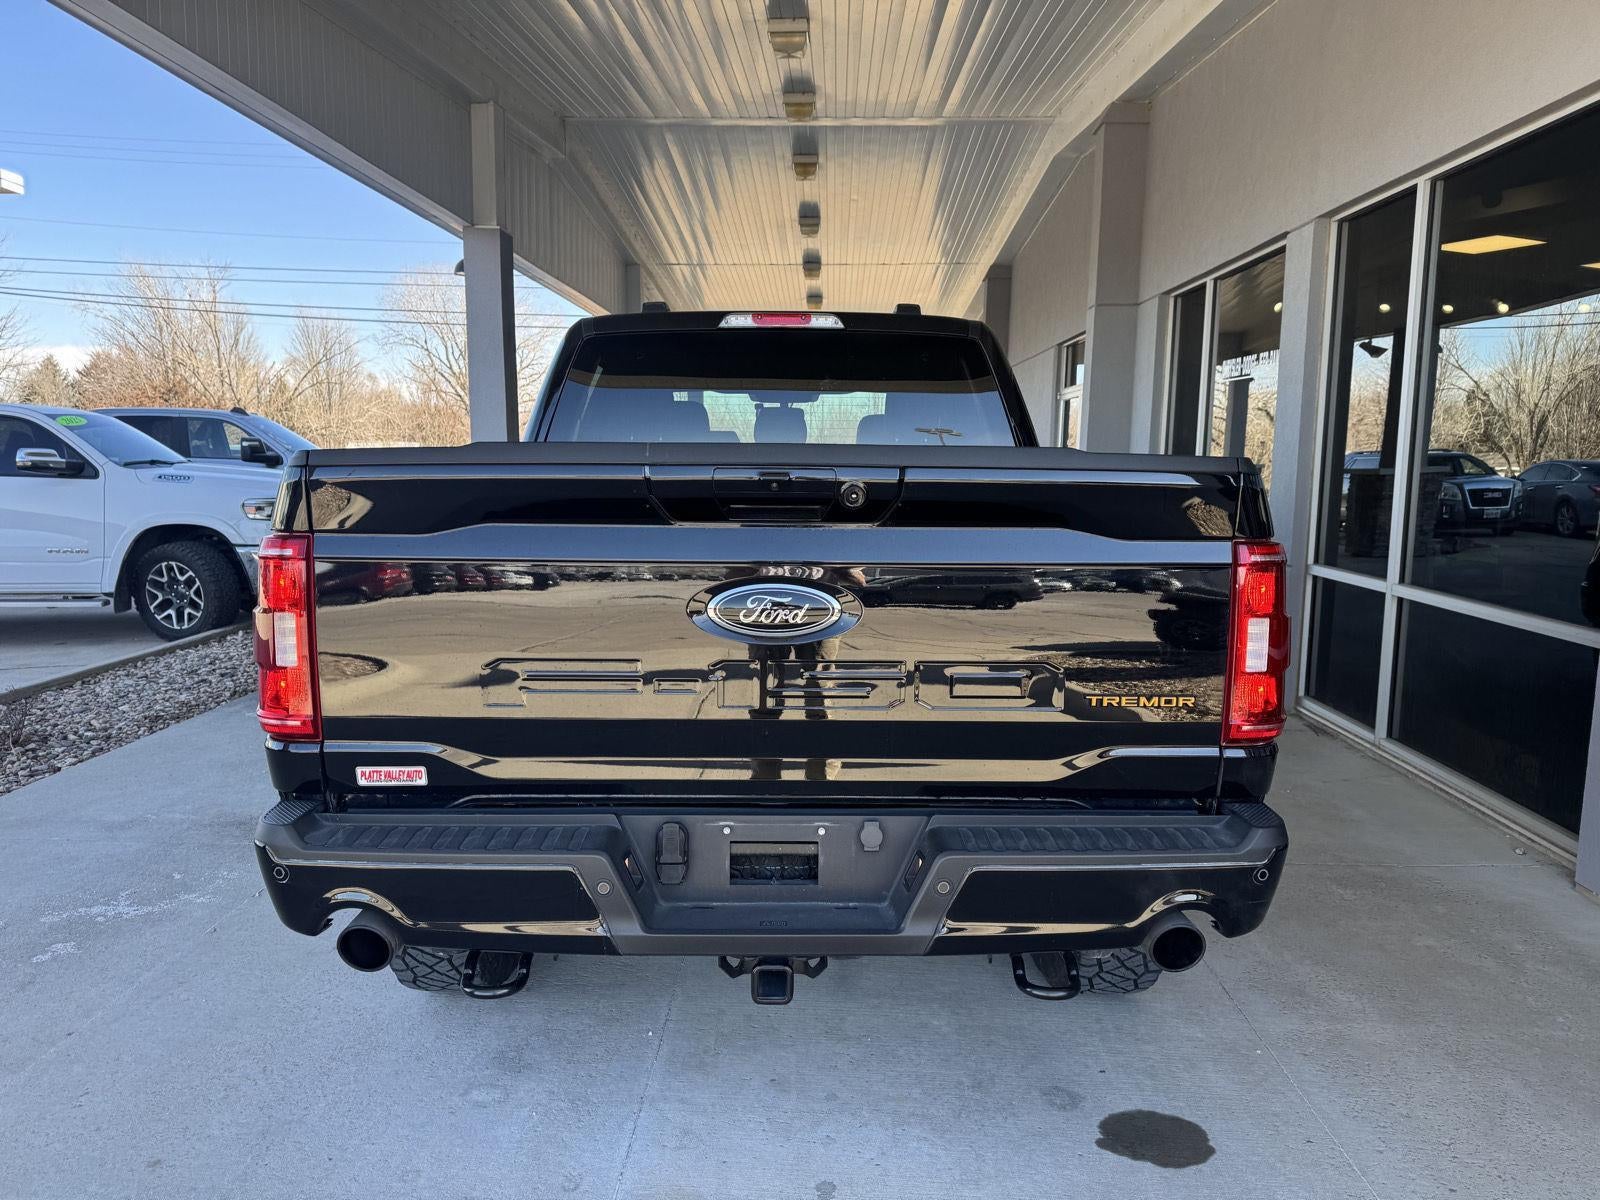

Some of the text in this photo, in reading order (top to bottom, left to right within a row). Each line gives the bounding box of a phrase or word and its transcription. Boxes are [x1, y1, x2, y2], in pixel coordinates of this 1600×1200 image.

[739, 595, 809, 625] Ford
[482, 658, 1064, 711] F-150
[1085, 695, 1196, 708] TREMOR
[360, 769, 423, 781] PLATTE VALLEY AUTO
